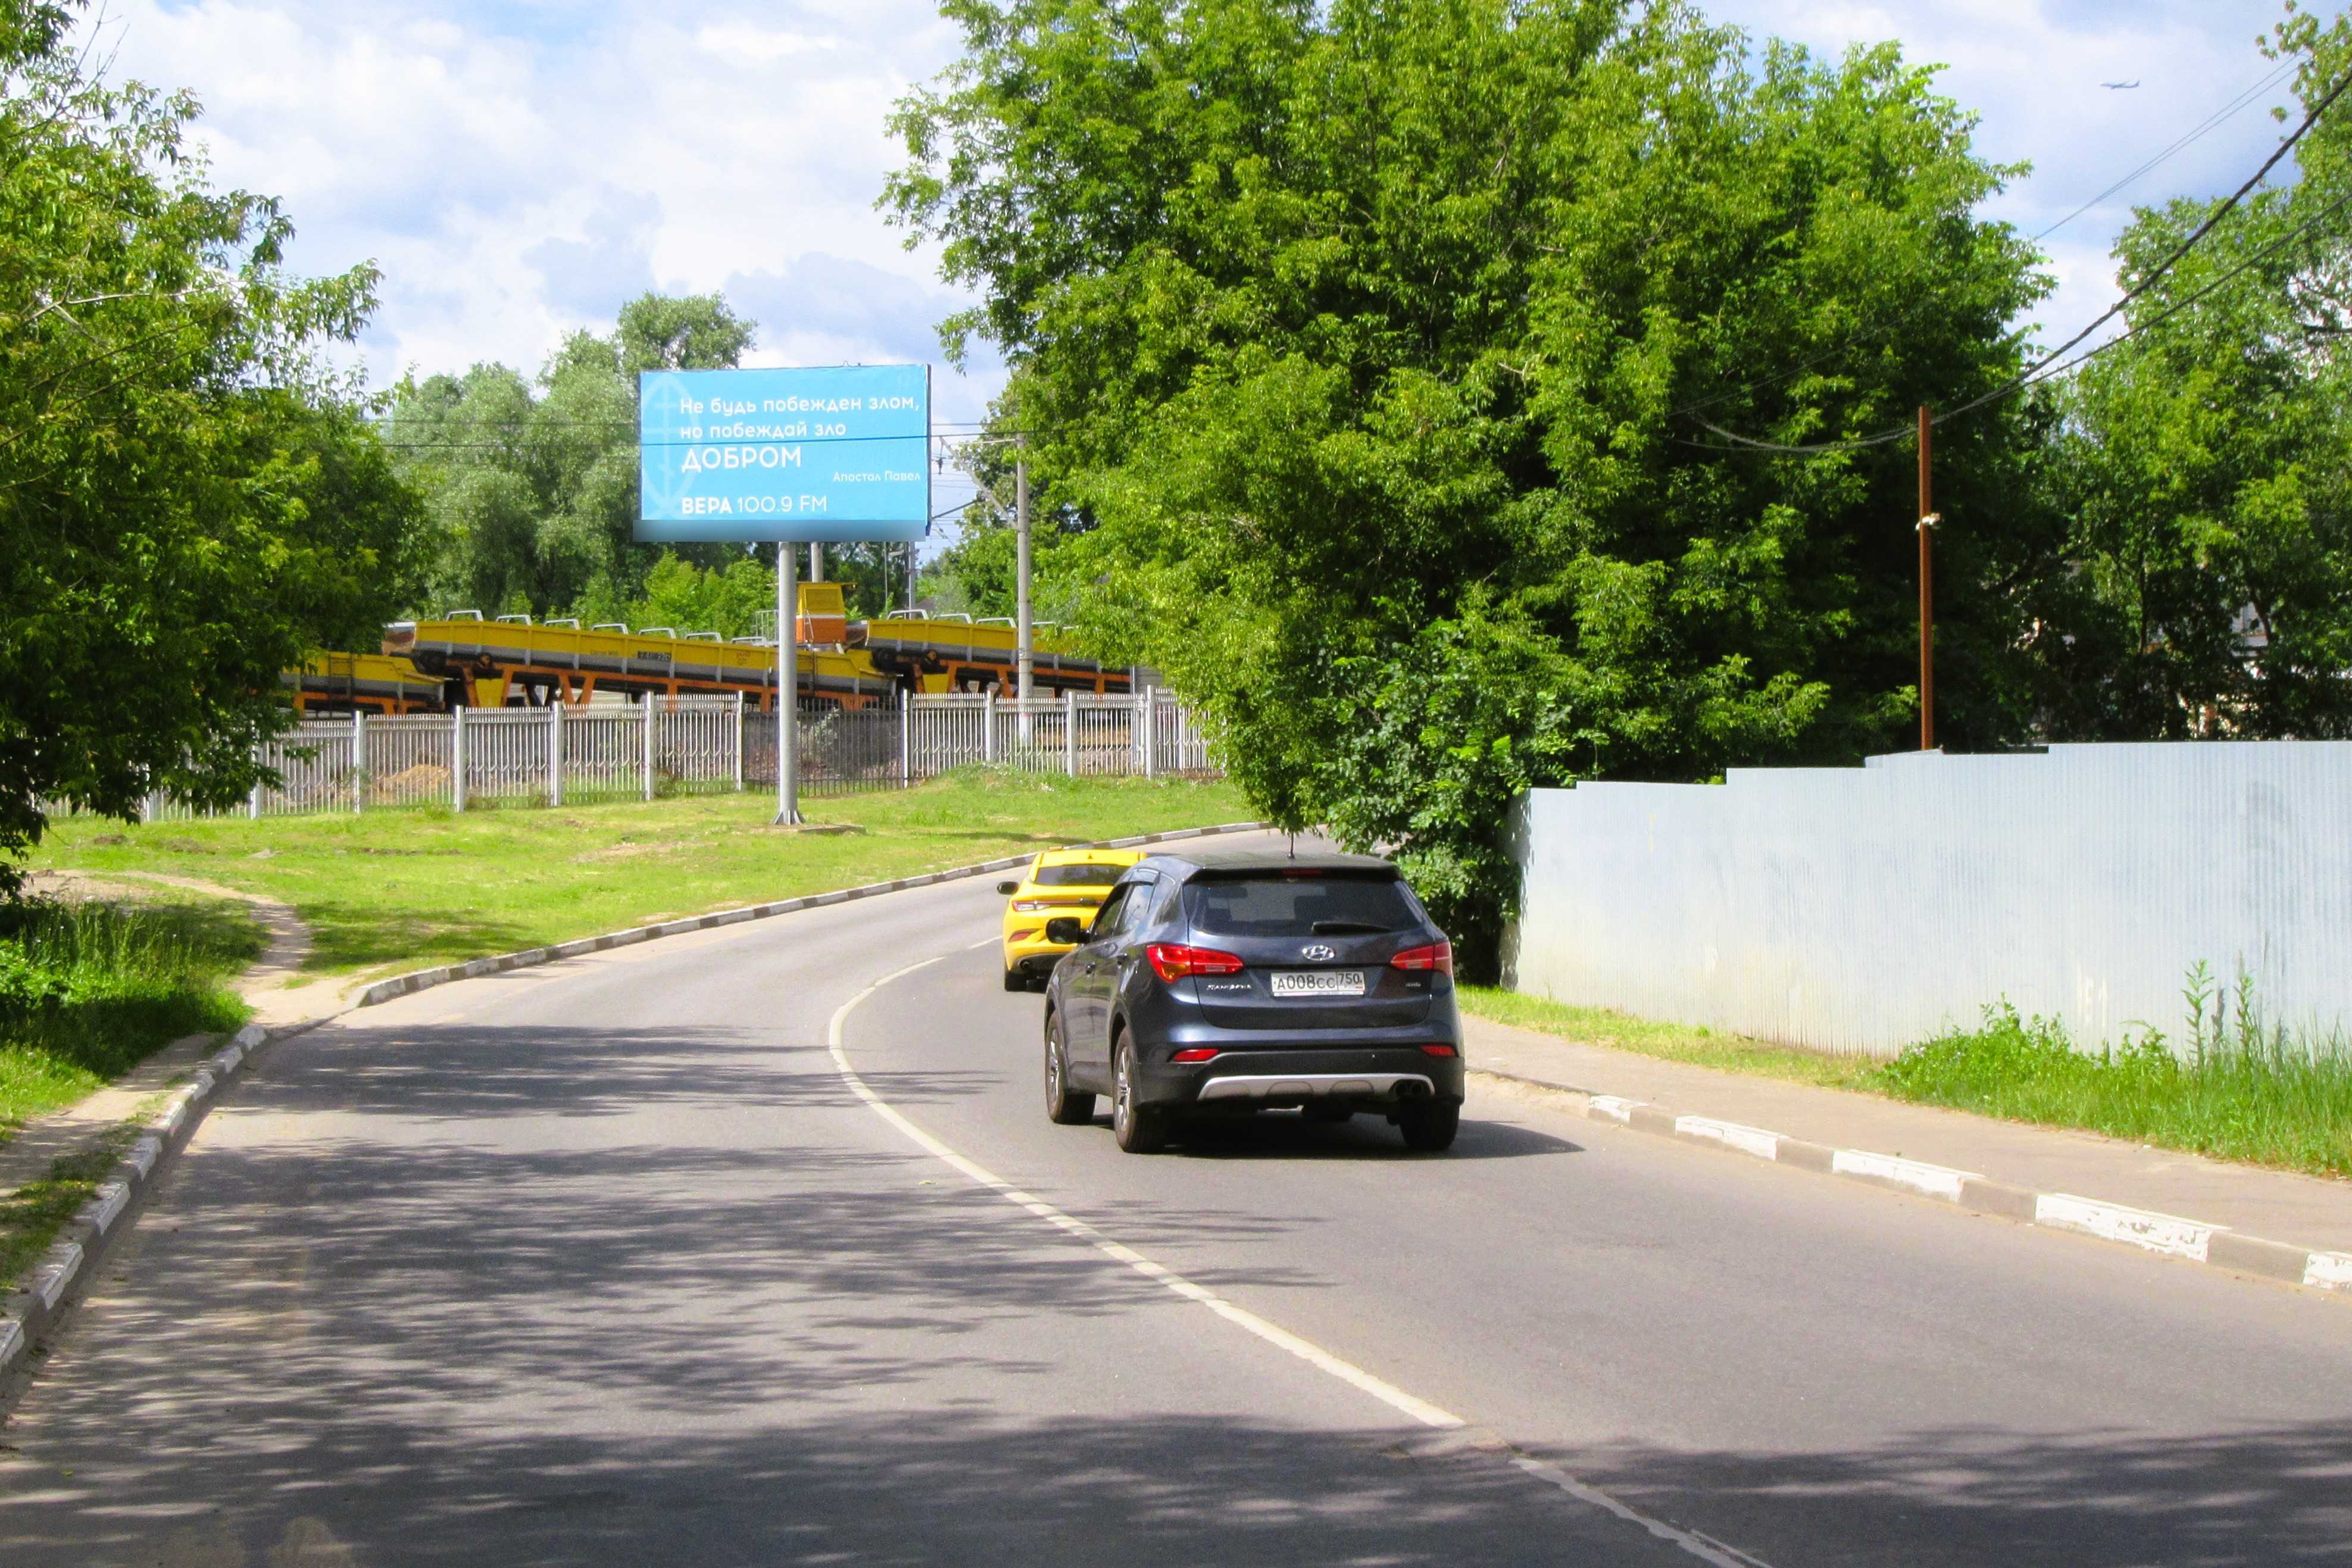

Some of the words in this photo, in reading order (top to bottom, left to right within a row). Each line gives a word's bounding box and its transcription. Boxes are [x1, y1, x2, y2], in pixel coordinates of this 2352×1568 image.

[680, 398, 704, 414] Не
[711, 397, 757, 417] будь
[764, 396, 862, 413] побежден
[869, 396, 920, 411] злом,
[680, 426, 703, 439] но
[710, 421, 807, 439] побеждай
[814, 423, 847, 436] зло
[682, 446, 802, 473] ДОБРОМ
[833, 472, 881, 482] Апостол
[885, 470, 921, 482] Павел
[682, 496, 733, 514] ВЕРА
[738, 496, 793, 513] 100.9
[799, 495, 827, 513] FM
